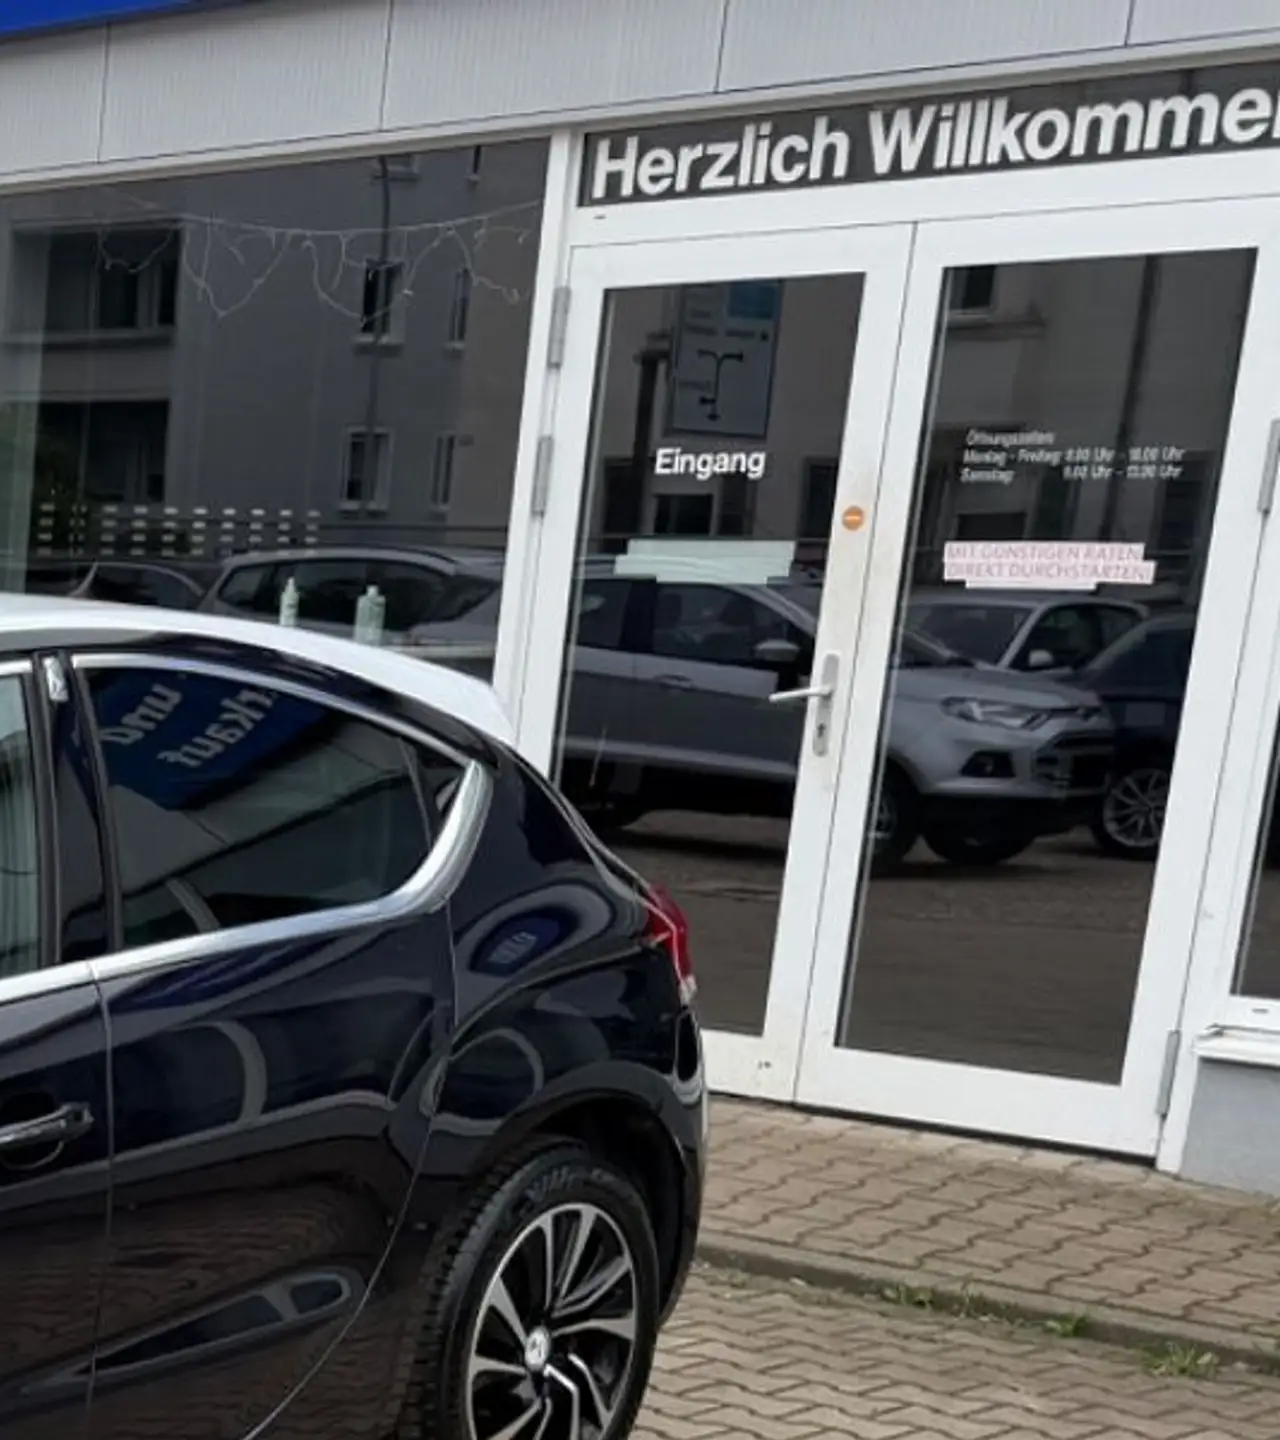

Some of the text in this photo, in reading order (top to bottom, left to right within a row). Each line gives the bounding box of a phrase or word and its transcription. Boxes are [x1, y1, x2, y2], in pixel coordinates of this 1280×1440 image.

[592, 115, 851, 199] Herzlich
[1093, 446, 1116, 463] Uhr
[1161, 445, 1187, 462] Uhr
[654, 447, 766, 480] Eingang
[1091, 464, 1114, 480] Uhr
[1159, 464, 1184, 480] Uhr
[946, 547, 974, 560] MIT
[946, 562, 1004, 578] DIREKT
